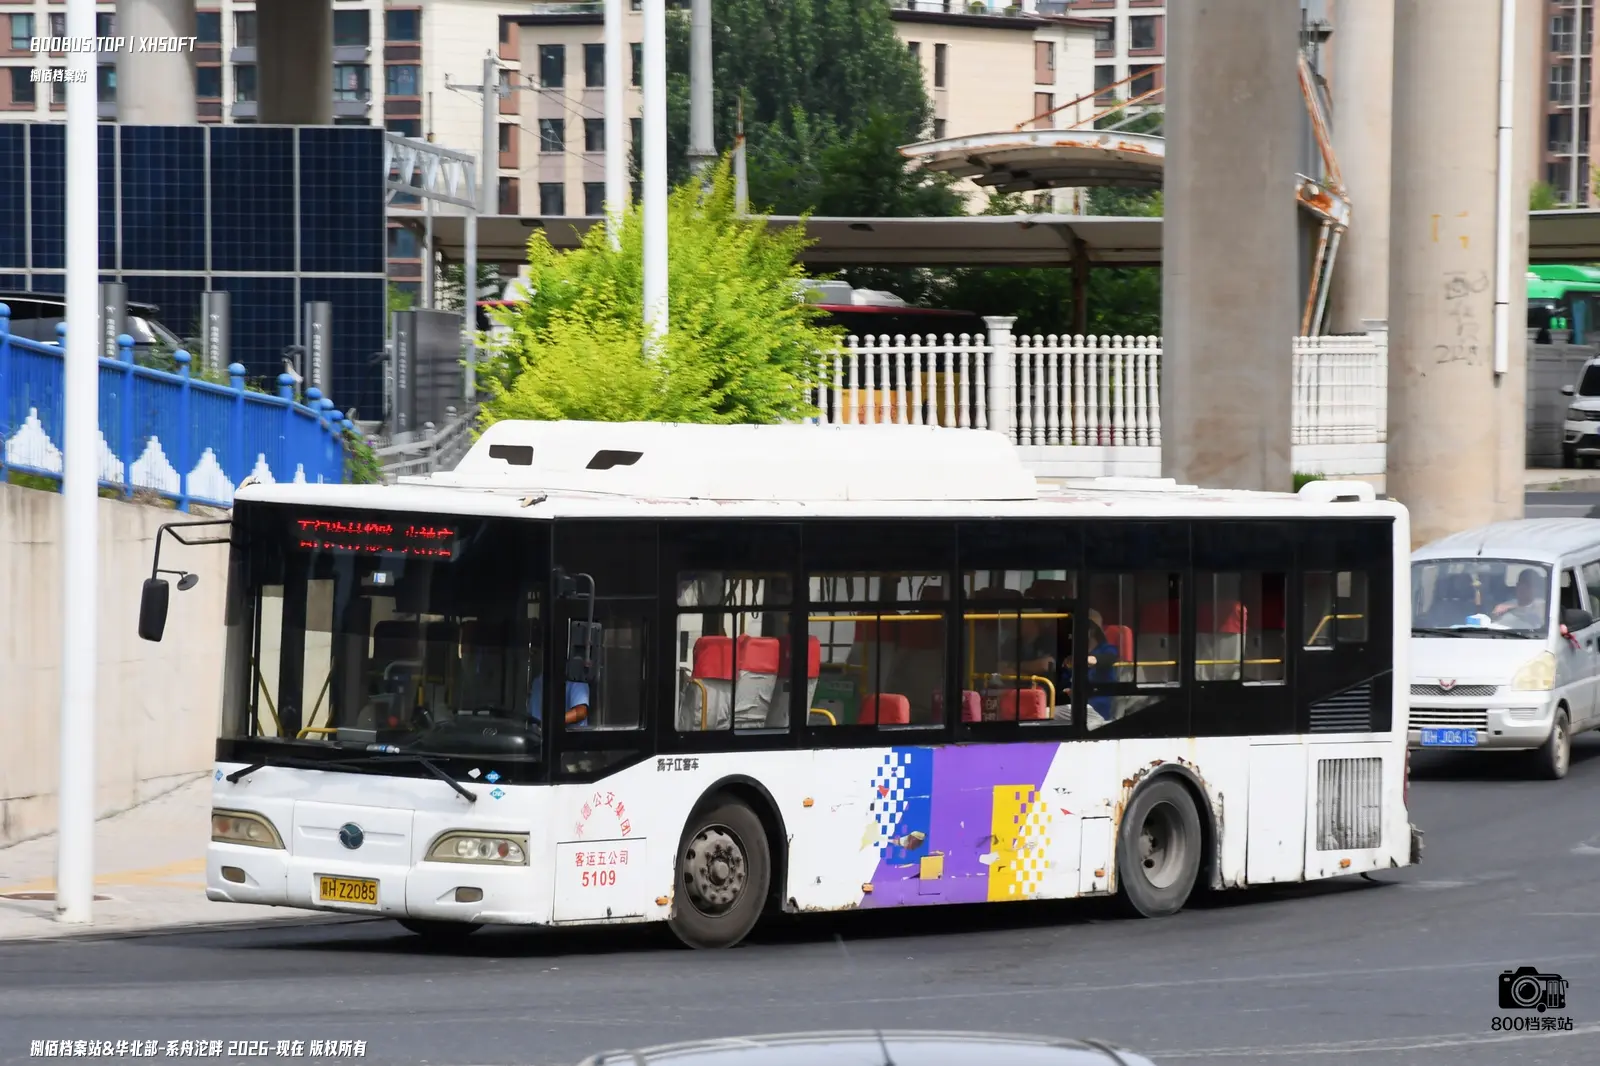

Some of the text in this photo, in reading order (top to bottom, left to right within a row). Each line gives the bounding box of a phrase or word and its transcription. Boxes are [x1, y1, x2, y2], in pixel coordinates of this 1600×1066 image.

[575, 850, 629, 867] 客运五公司
[582, 870, 616, 887] 5109
